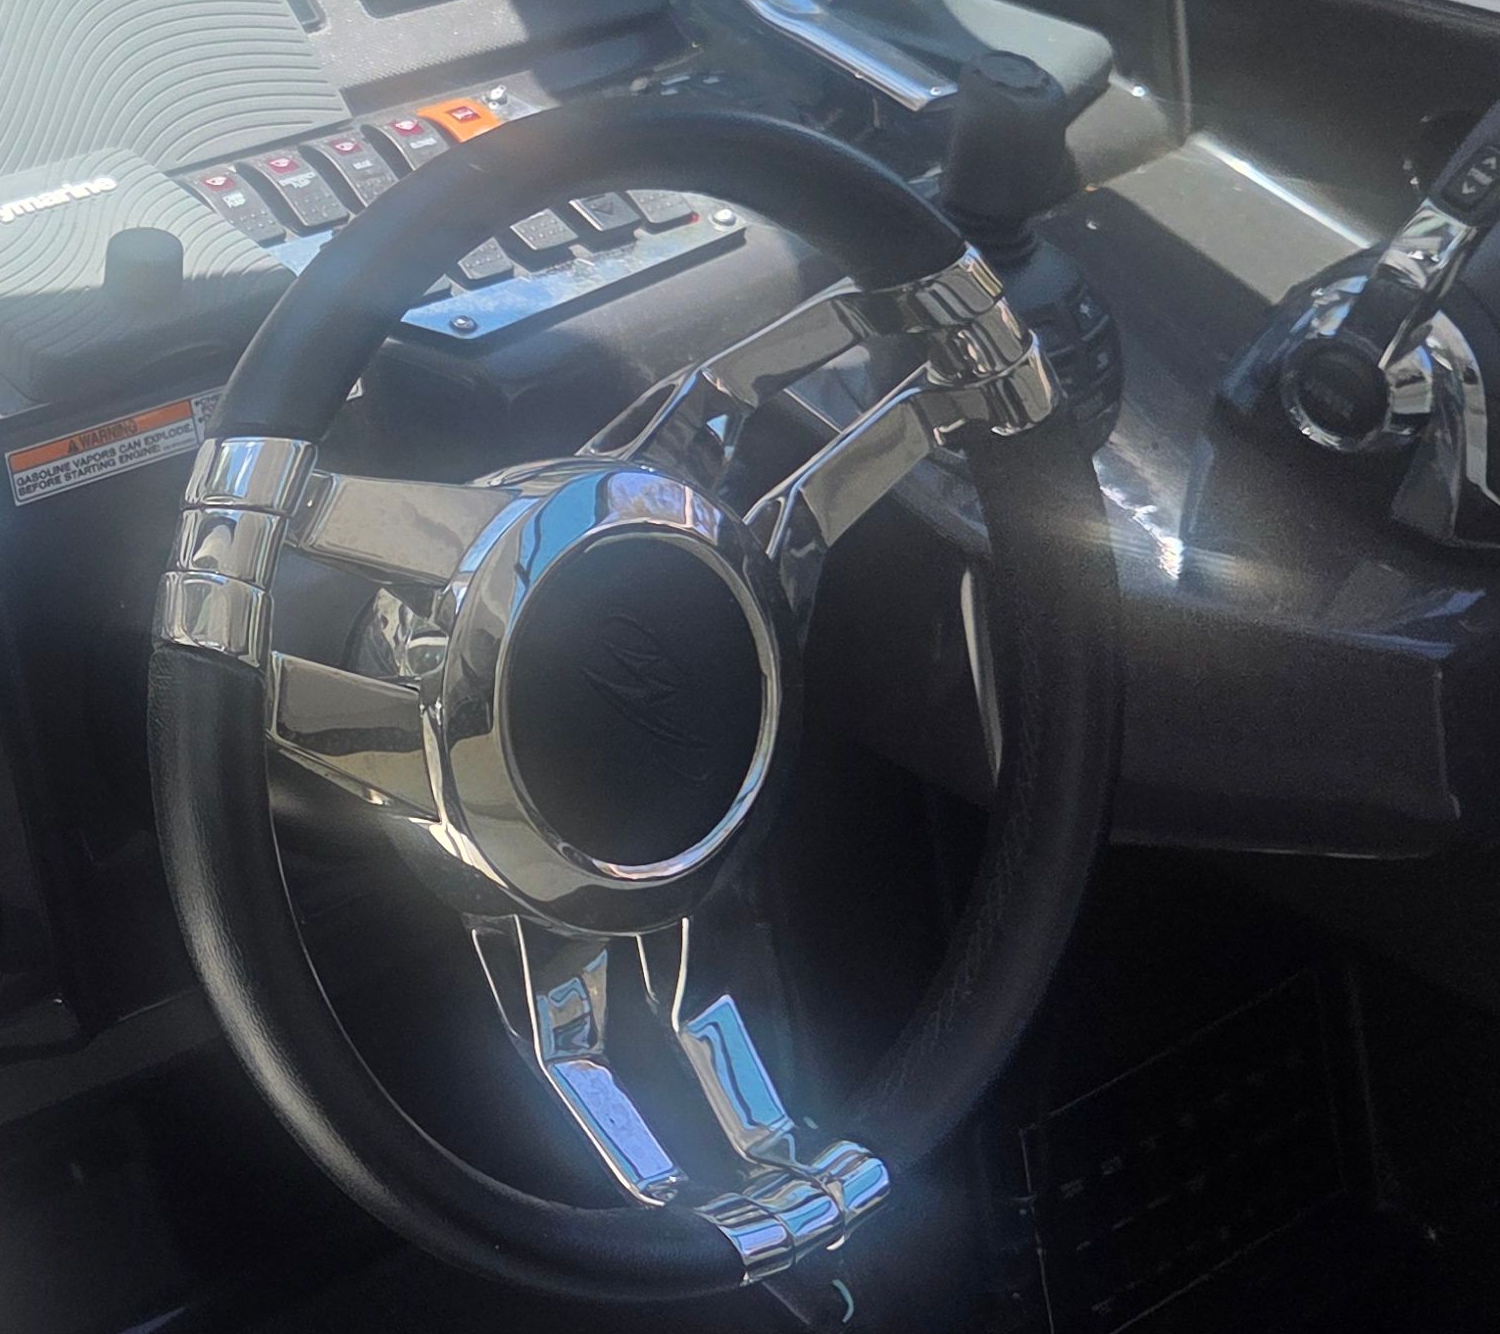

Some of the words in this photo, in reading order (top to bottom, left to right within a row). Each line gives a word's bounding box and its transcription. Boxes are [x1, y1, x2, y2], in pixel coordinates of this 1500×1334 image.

[79, 419, 138, 450] WARNING
[16, 462, 71, 488] GASOLINE
[72, 447, 117, 470] VAPORS
[119, 438, 142, 454] CAN
[18, 476, 62, 497] BEFORE
[64, 460, 116, 482] STARTING
